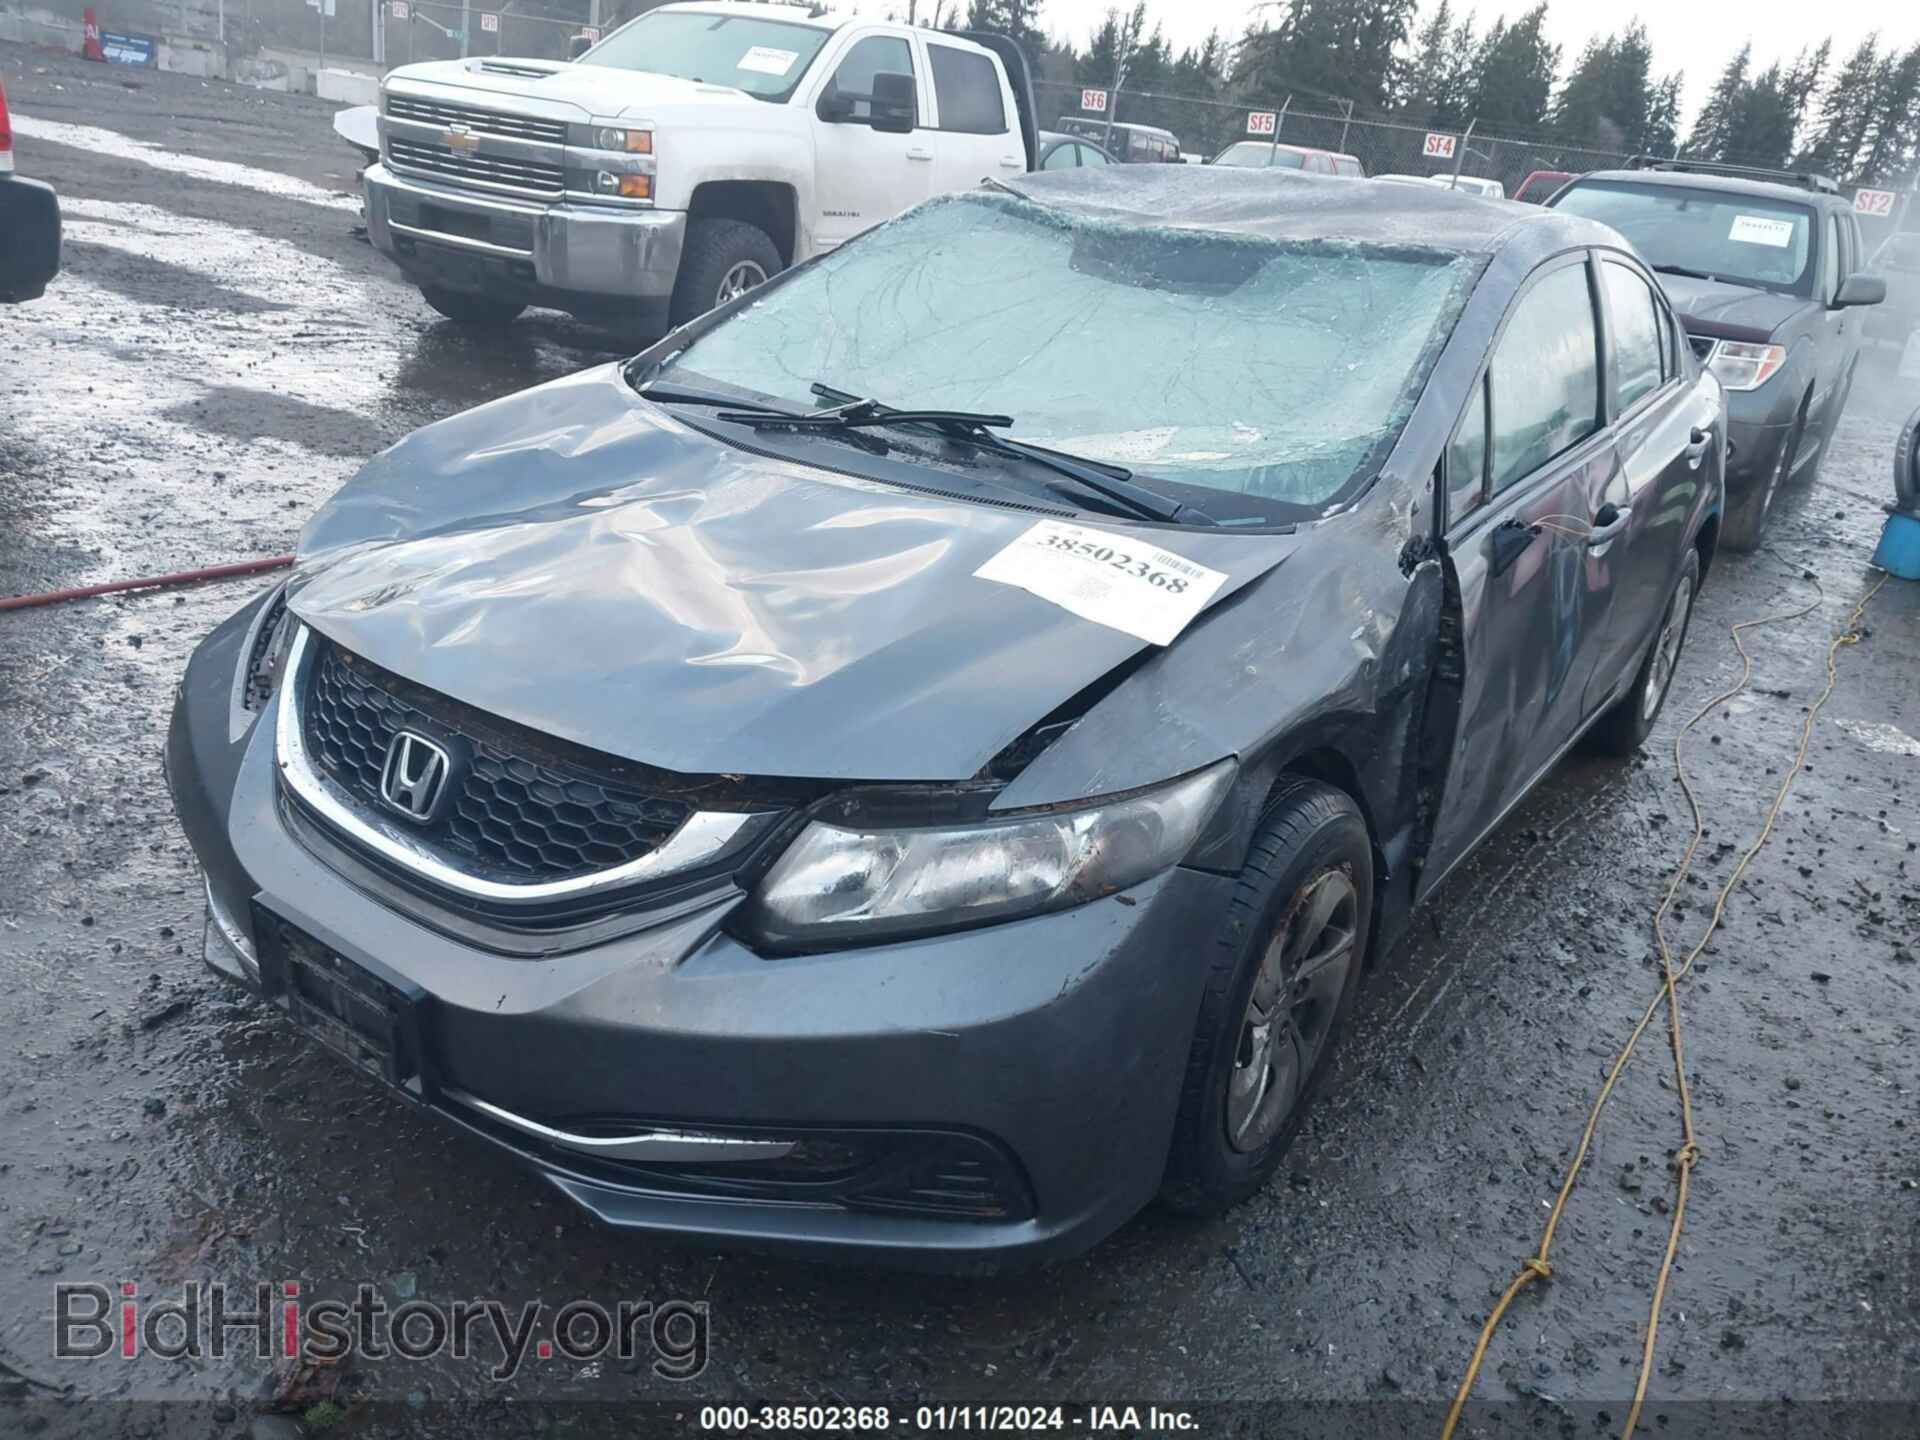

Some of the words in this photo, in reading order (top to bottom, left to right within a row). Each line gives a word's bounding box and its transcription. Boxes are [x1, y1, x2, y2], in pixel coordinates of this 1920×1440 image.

[1084, 91, 1105, 108] SF6
[1250, 114, 1273, 131] SF5
[1426, 136, 1453, 154] SF4
[1857, 192, 1889, 213] SF2
[1037, 535, 1190, 593] 38502368
